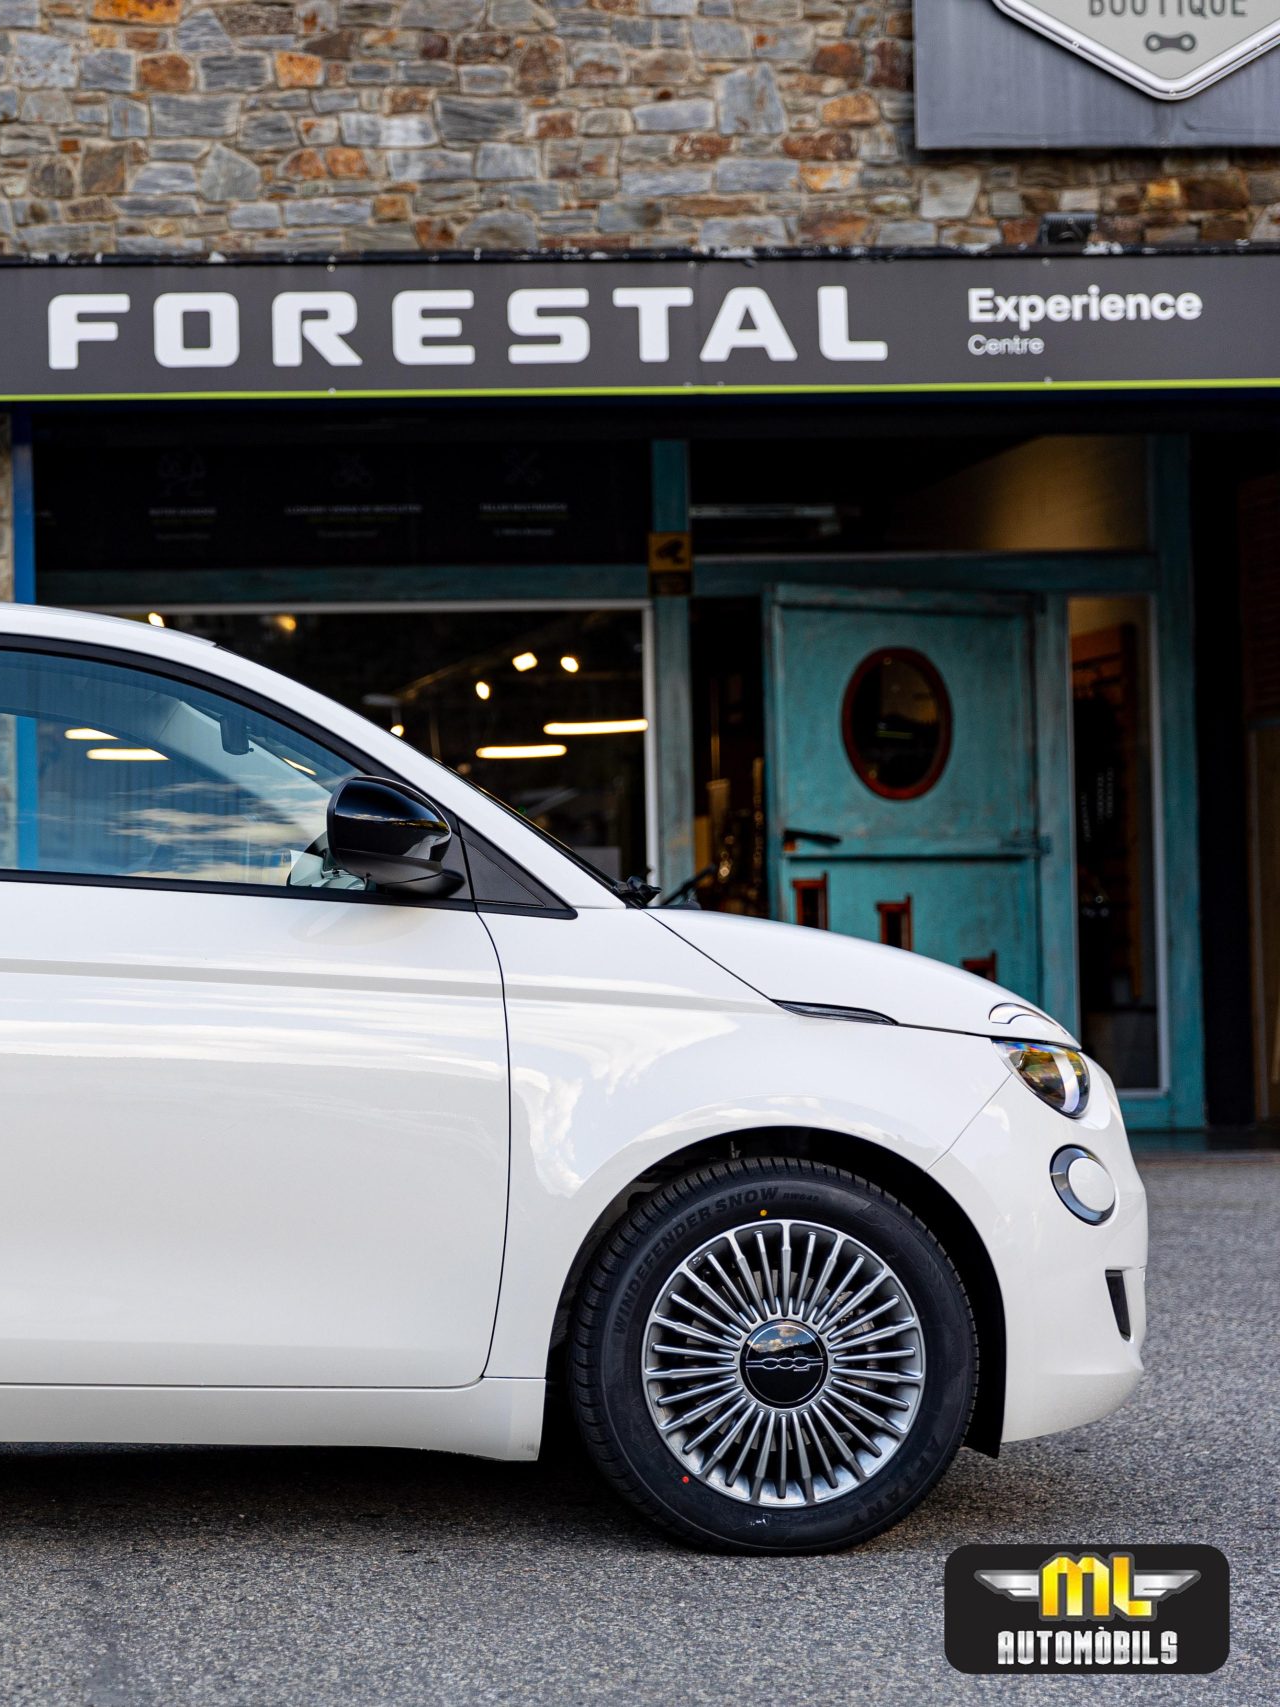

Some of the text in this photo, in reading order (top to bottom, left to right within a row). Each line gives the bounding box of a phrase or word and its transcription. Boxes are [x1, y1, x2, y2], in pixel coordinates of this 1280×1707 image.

[967, 284, 1204, 332] Experience
[47, 285, 889, 370] FORESTAL
[967, 333, 1045, 356] Centre
[714, 1186, 780, 1213] SNOW
